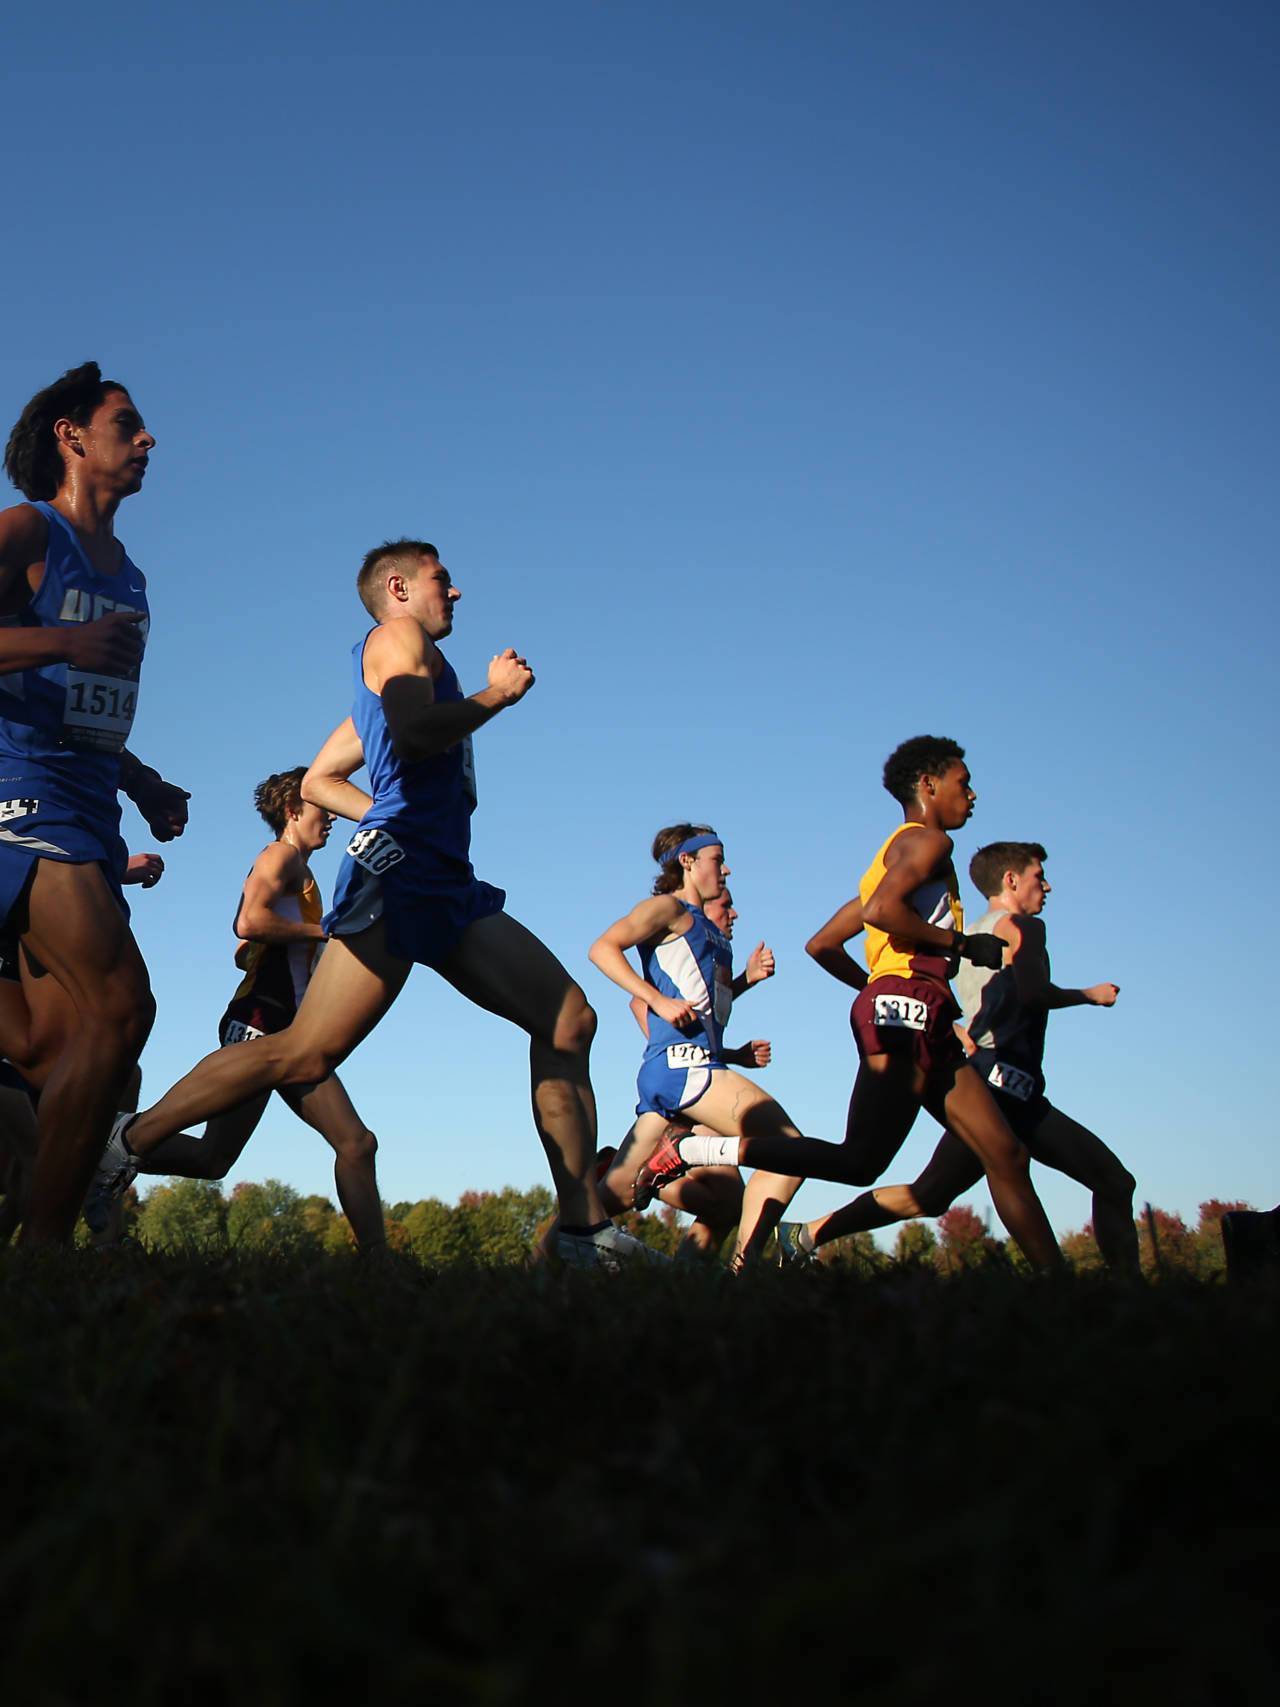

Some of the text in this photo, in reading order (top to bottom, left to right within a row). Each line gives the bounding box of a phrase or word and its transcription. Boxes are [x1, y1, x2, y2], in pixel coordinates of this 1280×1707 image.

[71, 682, 136, 721] 1514
[877, 1000, 925, 1023] 1312
[227, 1023, 262, 1043] 131
